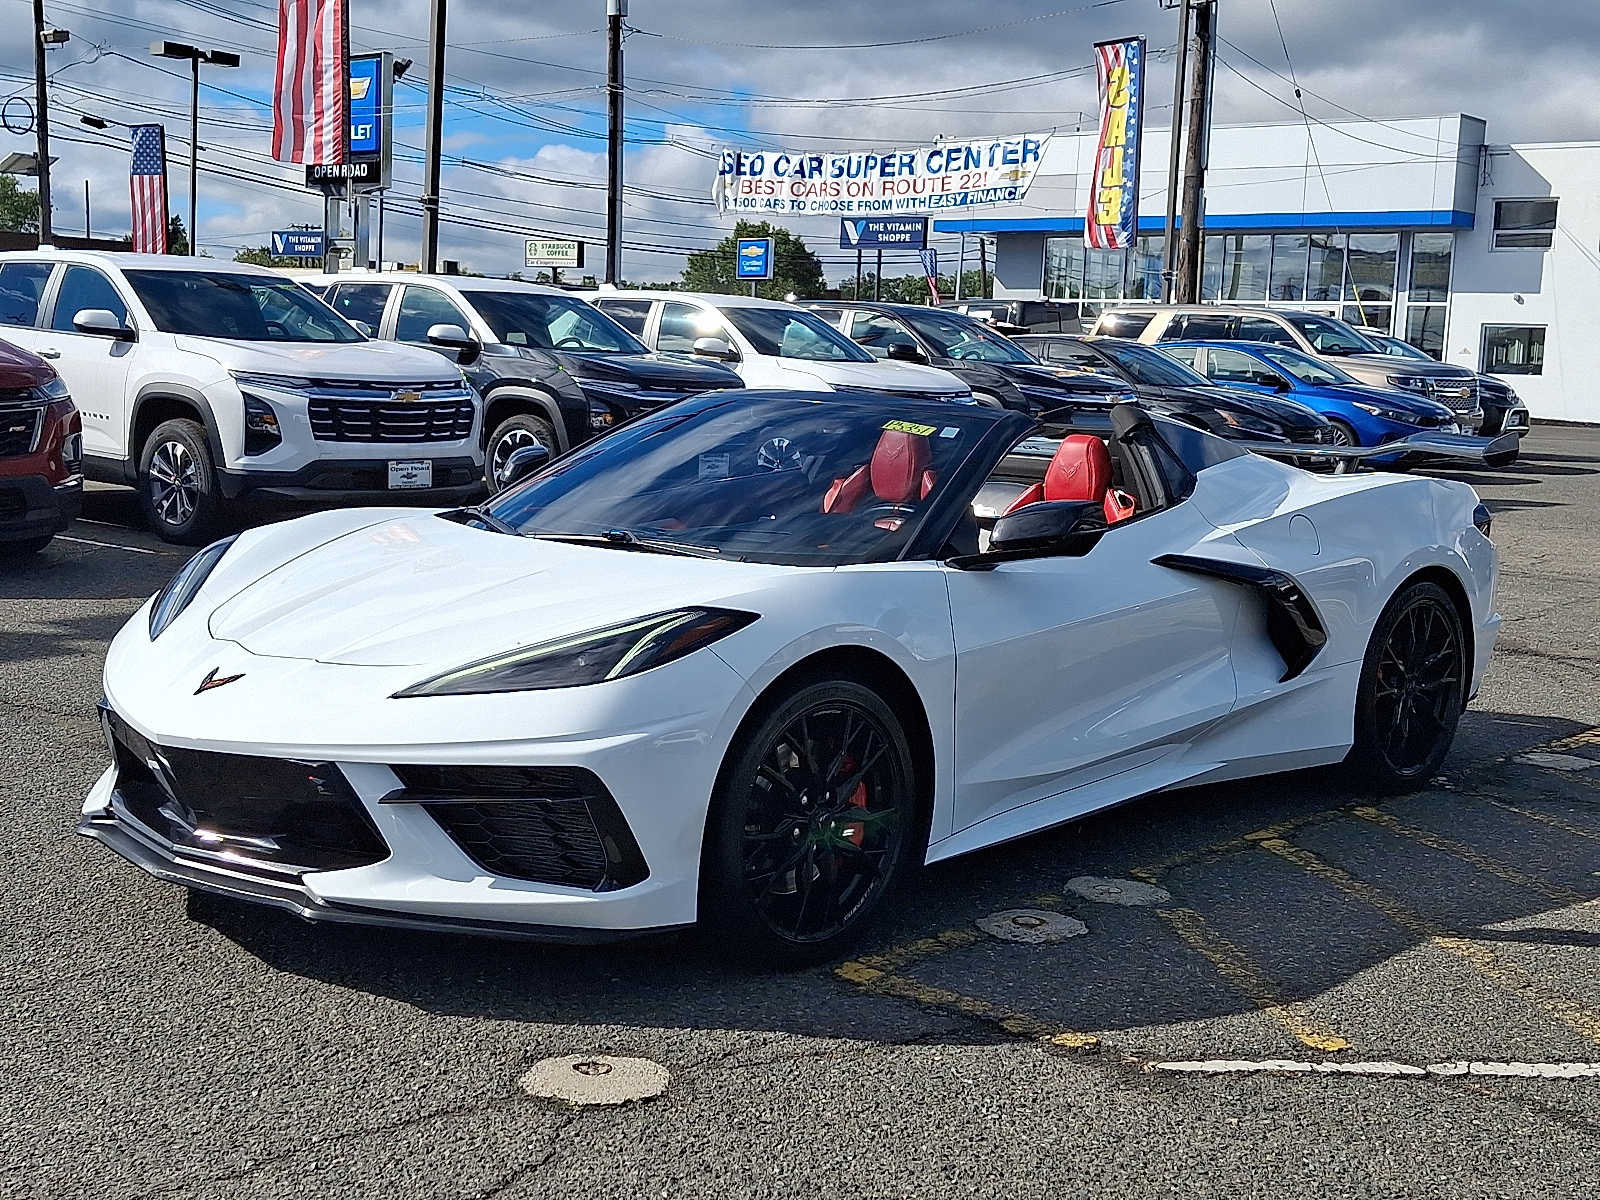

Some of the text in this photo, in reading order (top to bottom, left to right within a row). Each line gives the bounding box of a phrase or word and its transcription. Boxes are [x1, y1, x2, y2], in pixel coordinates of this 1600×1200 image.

[719, 139, 1041, 179] SED CAR SUPER CENTER
[314, 165, 340, 178] OPEN
[741, 171, 988, 197] BEST CARS ON ROUTE 22!
[790, 199, 806, 211] TO
[810, 199, 854, 212] CHOOSE
[857, 199, 893, 211] FROM
[895, 196, 927, 210] WITH
[930, 193, 966, 209] EASY
[868, 222, 922, 232] THE VITAMIN
[288, 235, 299, 243] THE
[877, 233, 912, 242] SHOPPE
